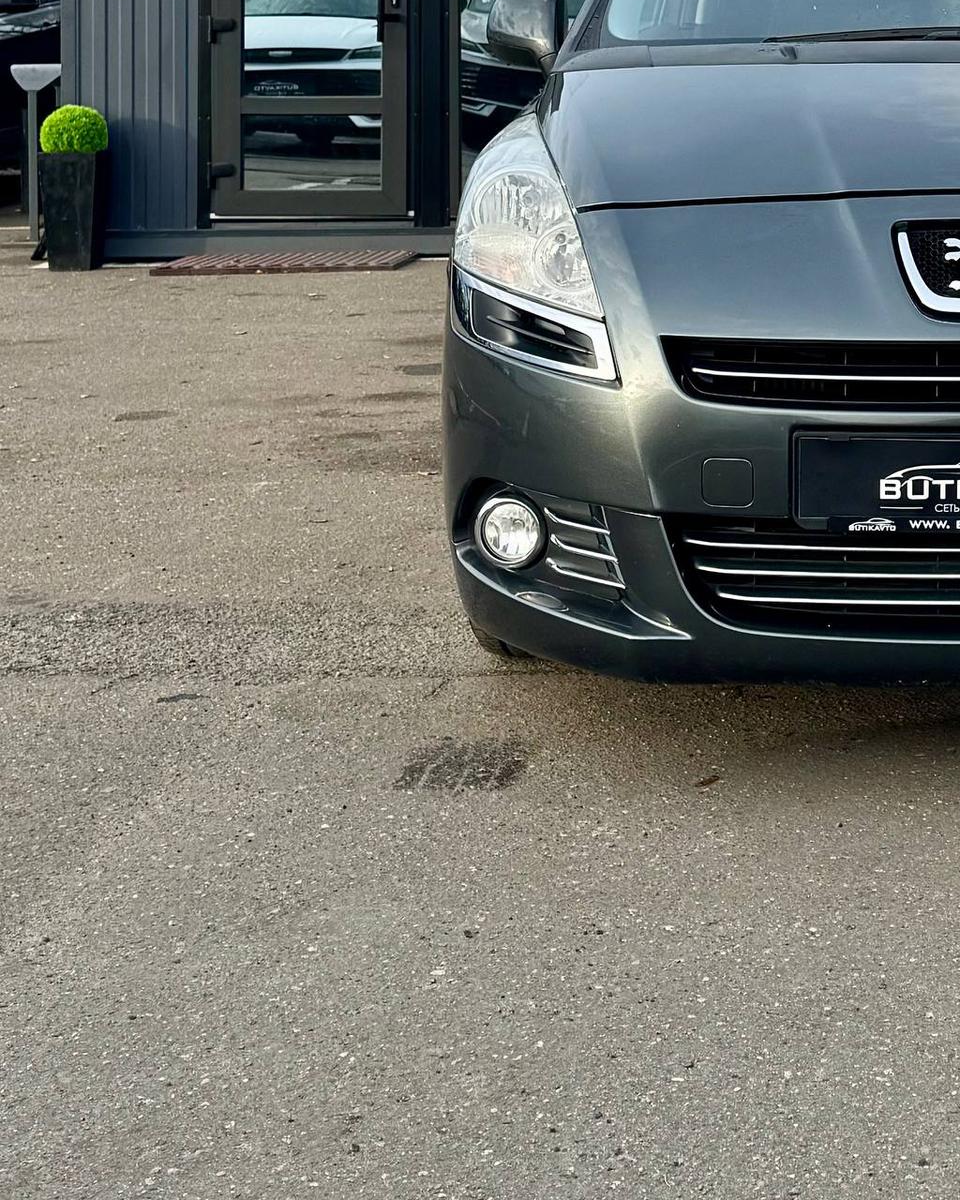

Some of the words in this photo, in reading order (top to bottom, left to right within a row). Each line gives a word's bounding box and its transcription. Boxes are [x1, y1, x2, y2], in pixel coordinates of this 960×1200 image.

[934, 503, 960, 514] СЕТЬ
[848, 524, 897, 532] BUTIKAVTO
[908, 519, 951, 530] WWW.
